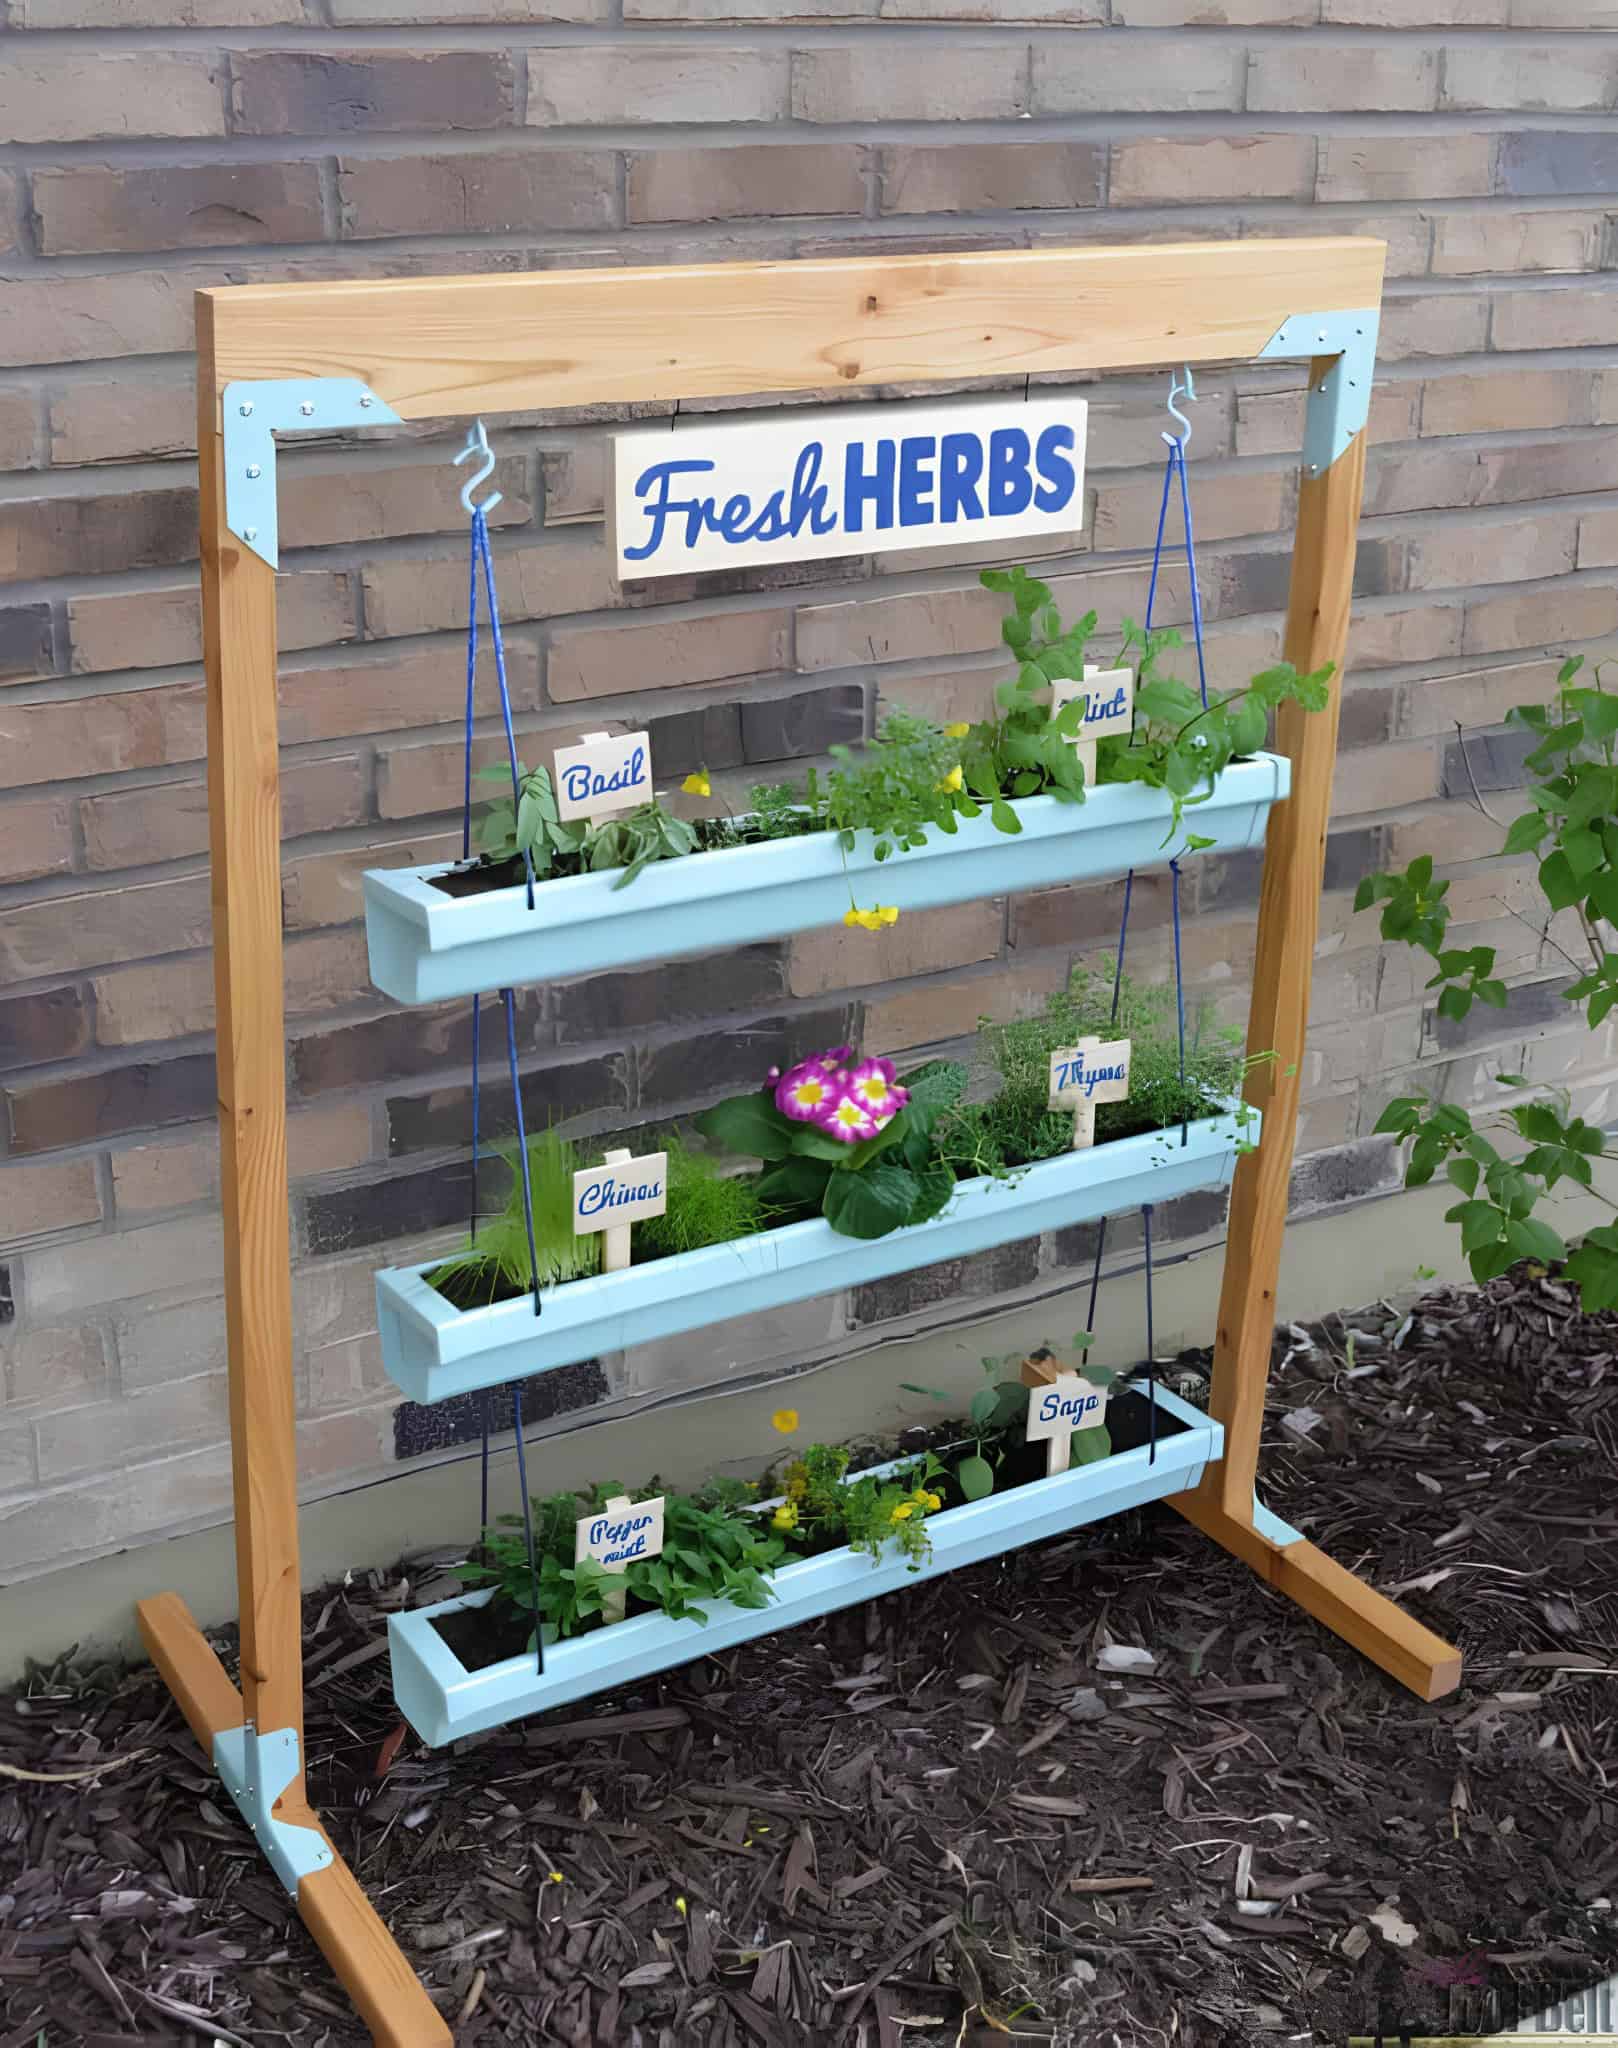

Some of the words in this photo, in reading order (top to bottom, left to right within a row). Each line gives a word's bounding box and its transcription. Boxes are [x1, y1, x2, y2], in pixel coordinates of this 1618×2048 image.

[624, 441, 838, 562] Fresh
[844, 424, 1076, 533] HERBS
[561, 746, 646, 802] Basil
